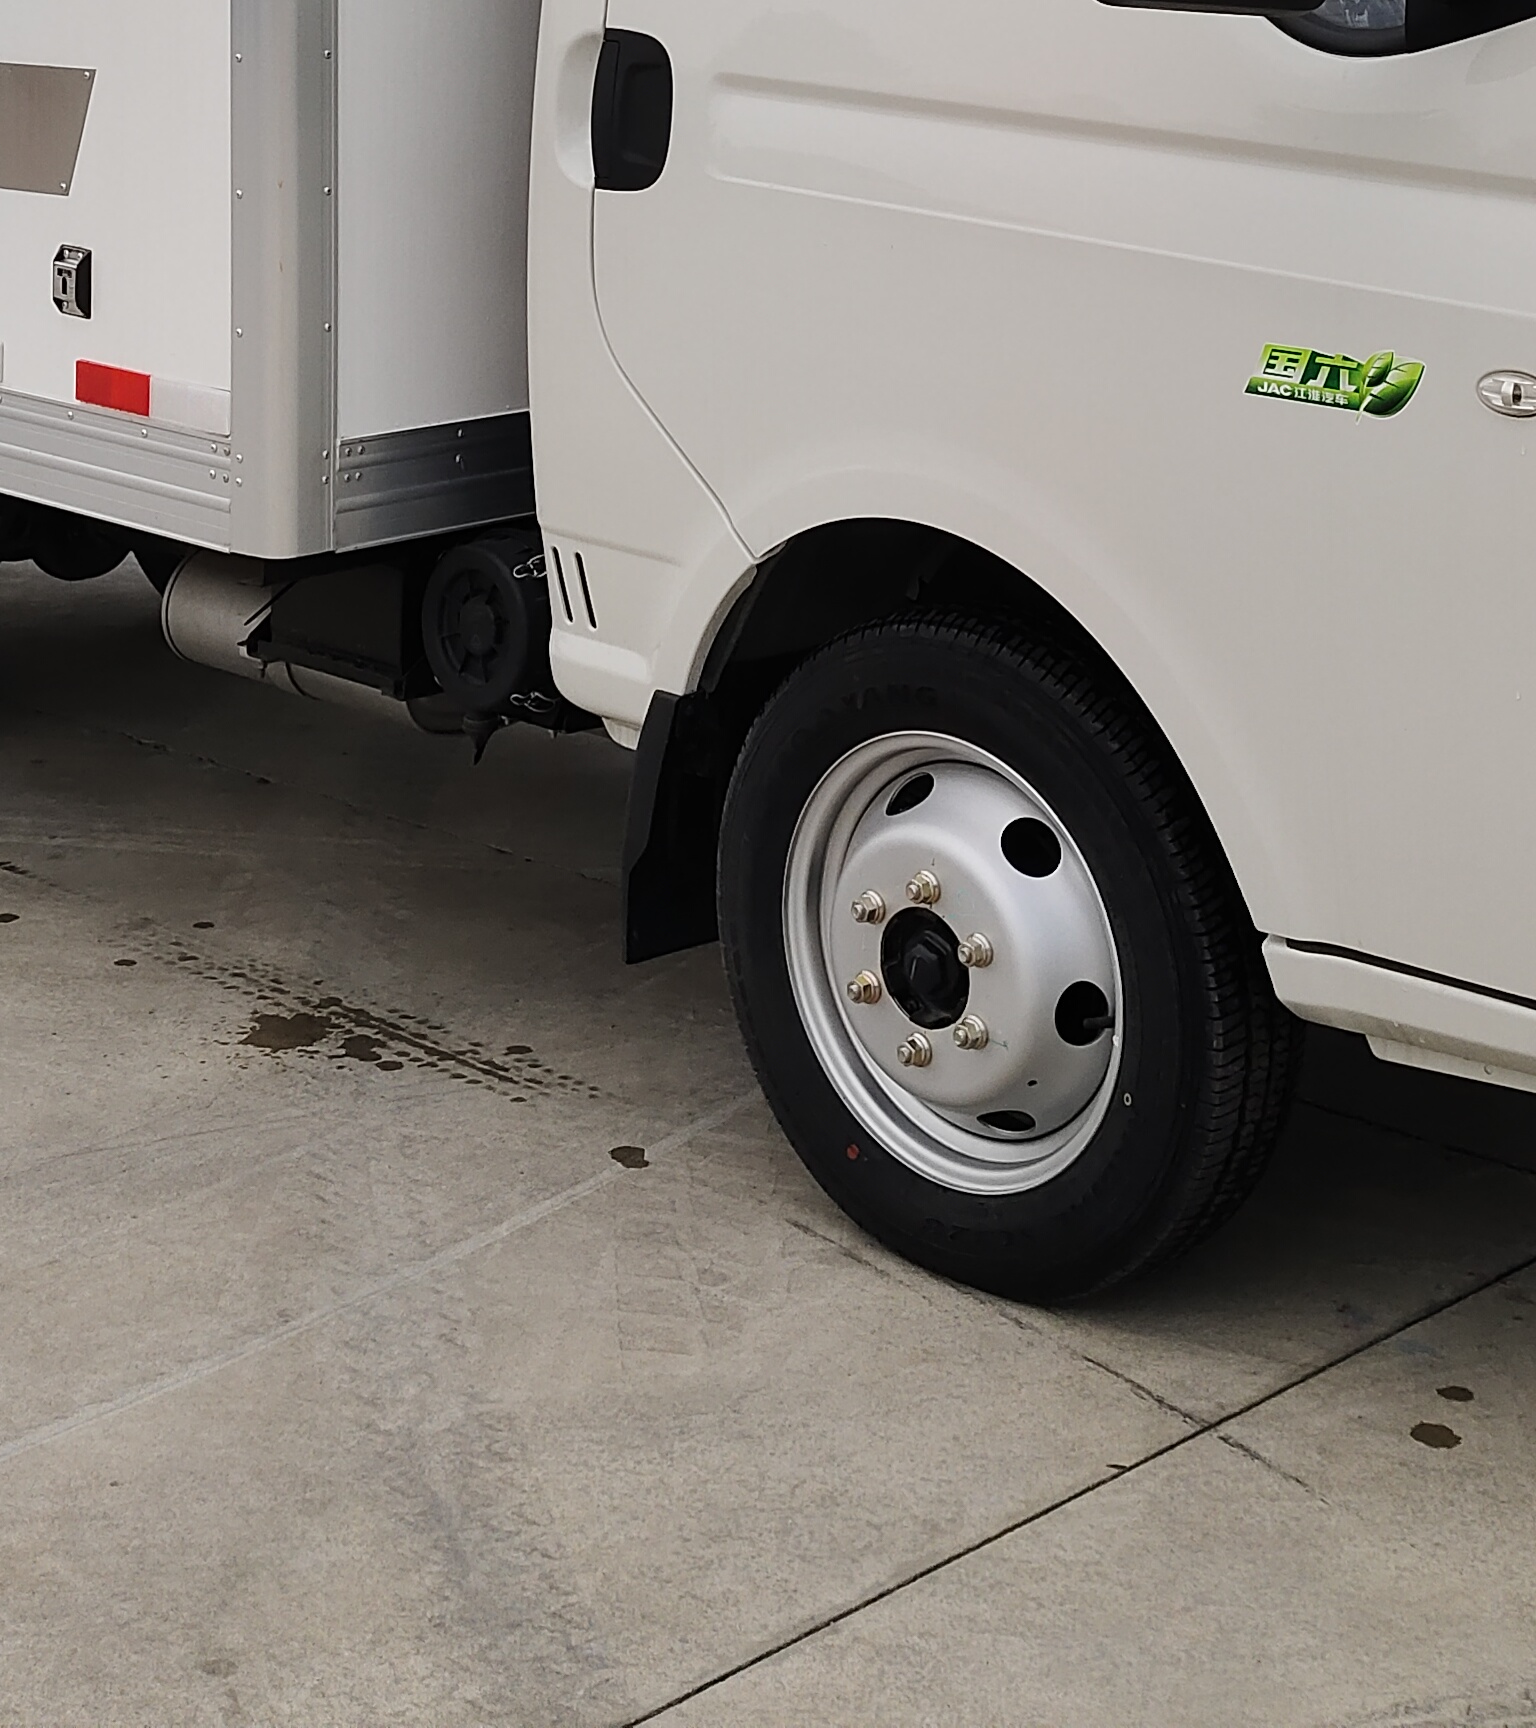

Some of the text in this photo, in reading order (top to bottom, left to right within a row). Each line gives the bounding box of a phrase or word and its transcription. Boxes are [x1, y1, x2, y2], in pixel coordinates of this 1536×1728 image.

[1257, 381, 1349, 406] JAC 江淮汽车
